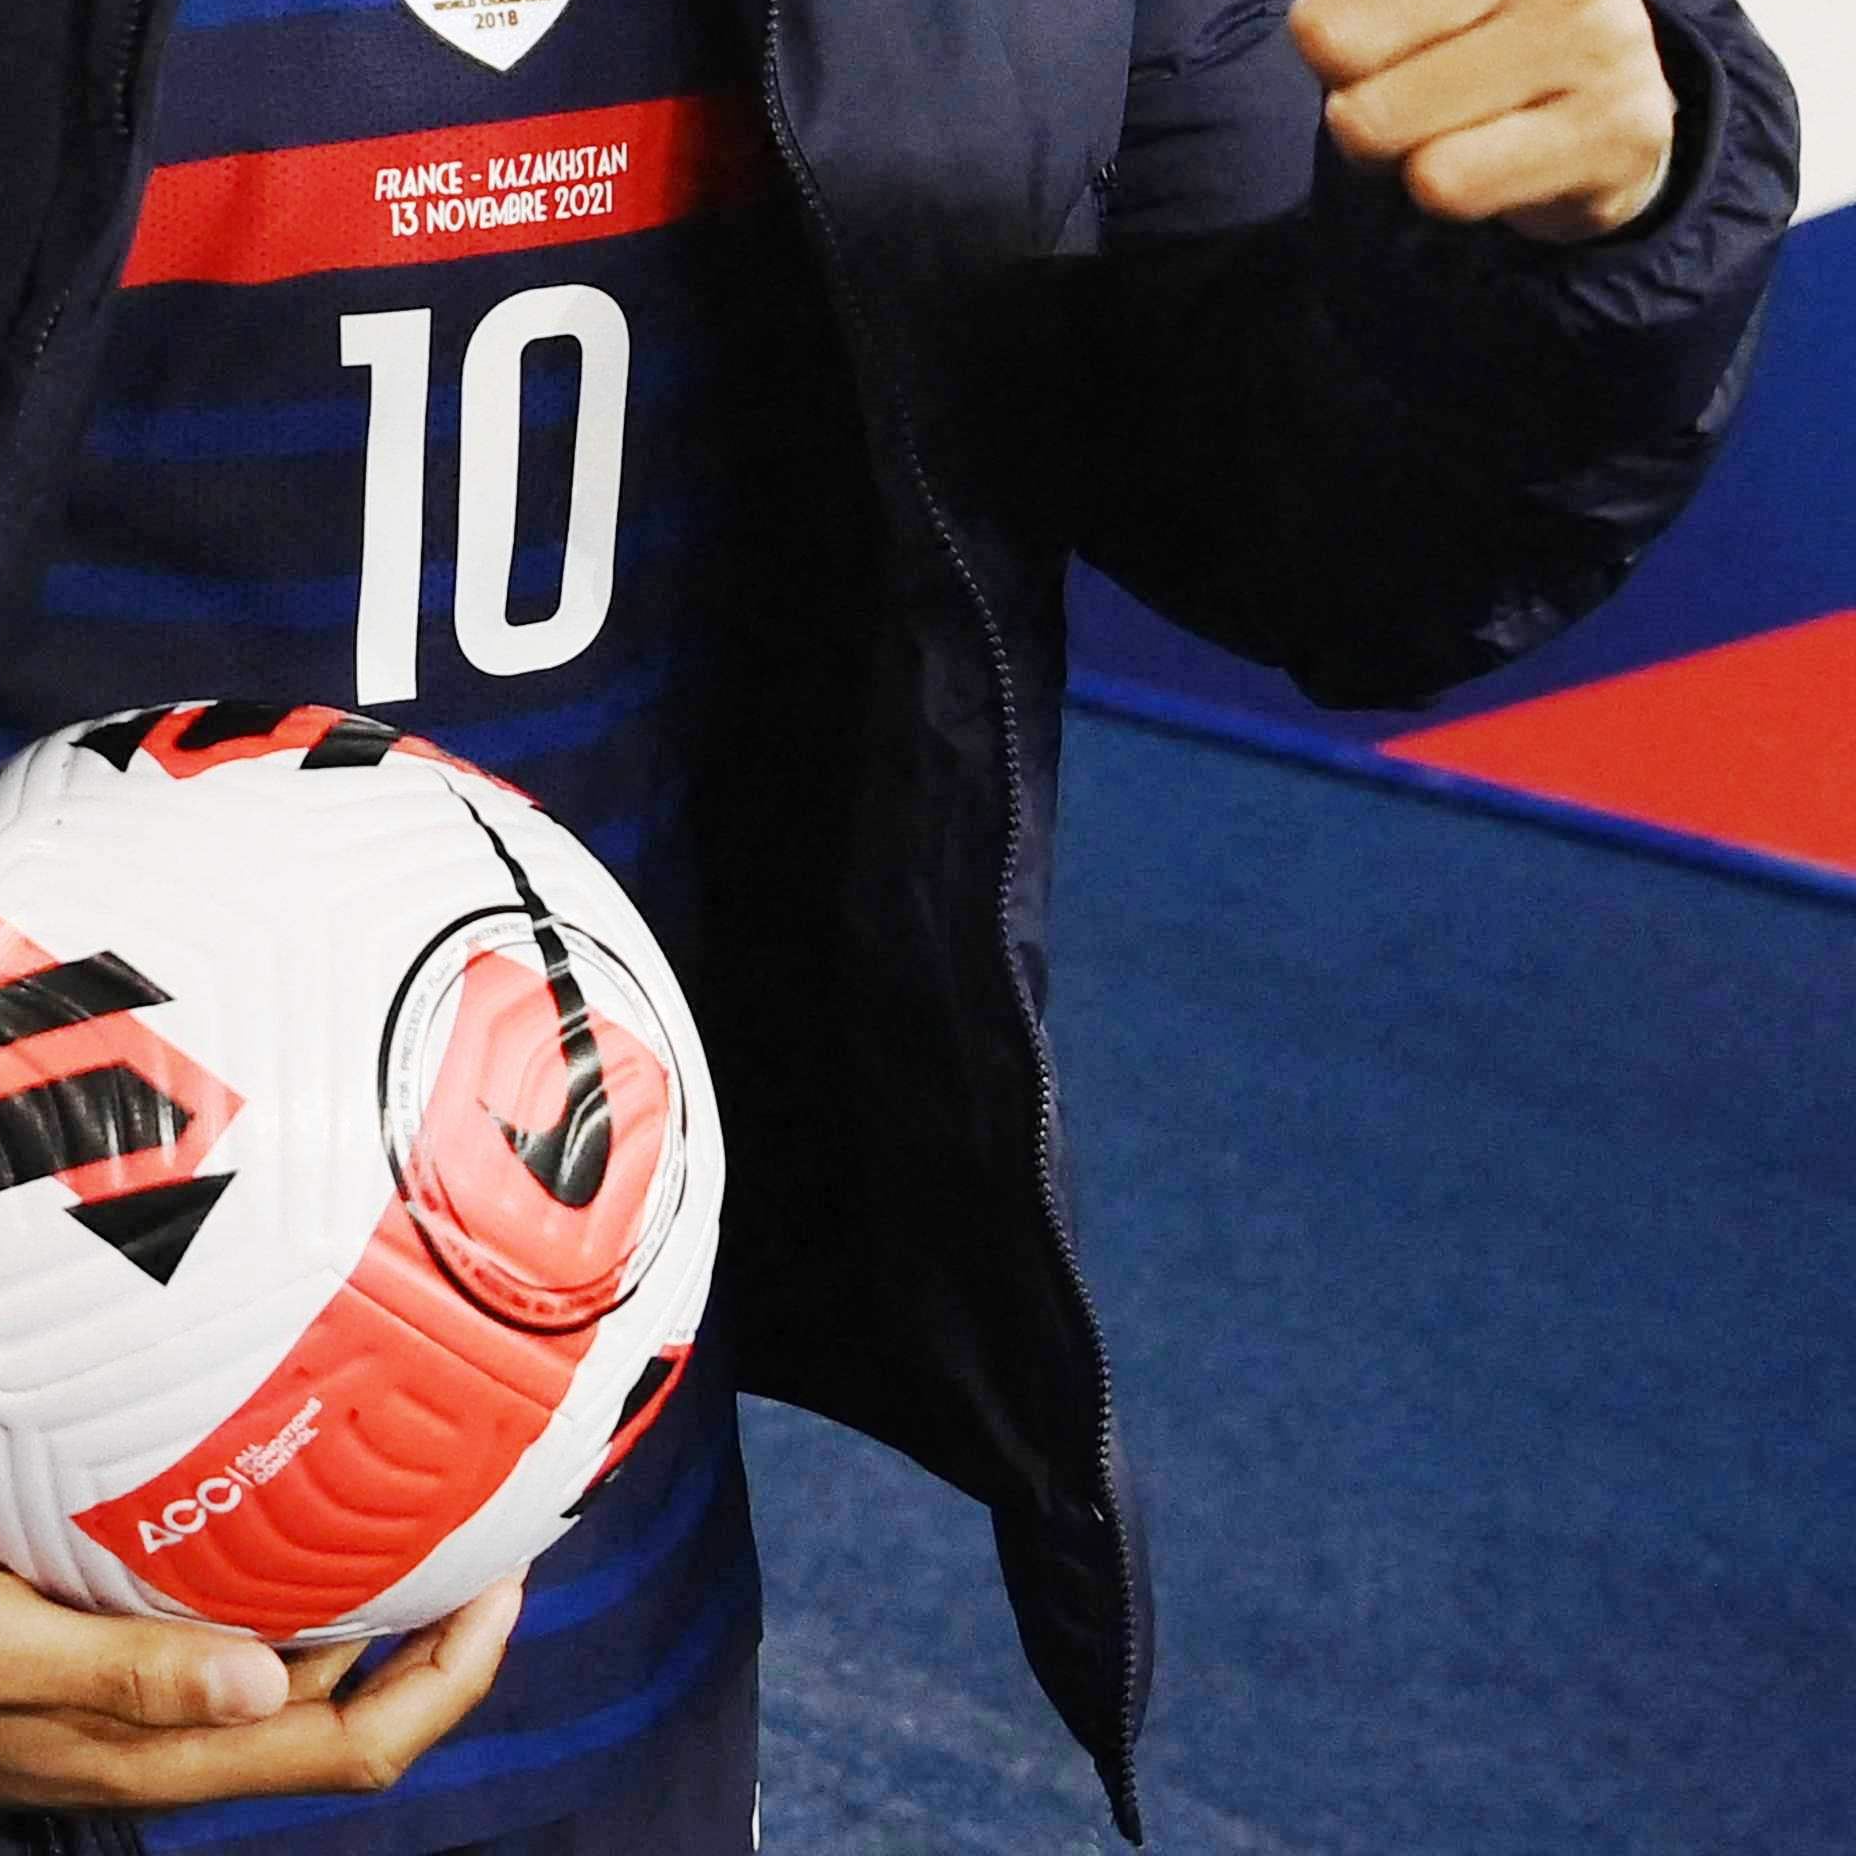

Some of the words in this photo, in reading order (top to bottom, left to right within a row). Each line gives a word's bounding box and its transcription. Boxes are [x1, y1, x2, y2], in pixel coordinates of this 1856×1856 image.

[473, 9, 519, 29] 2018
[374, 161, 464, 202] FRANCE
[487, 142, 629, 192] KAZAKHSTAN
[389, 202, 420, 237] 13
[425, 188, 548, 234] NOVEMBRE
[554, 180, 614, 220] 2021
[340, 283, 631, 707] 10
[137, 1476, 243, 1555] ACC
